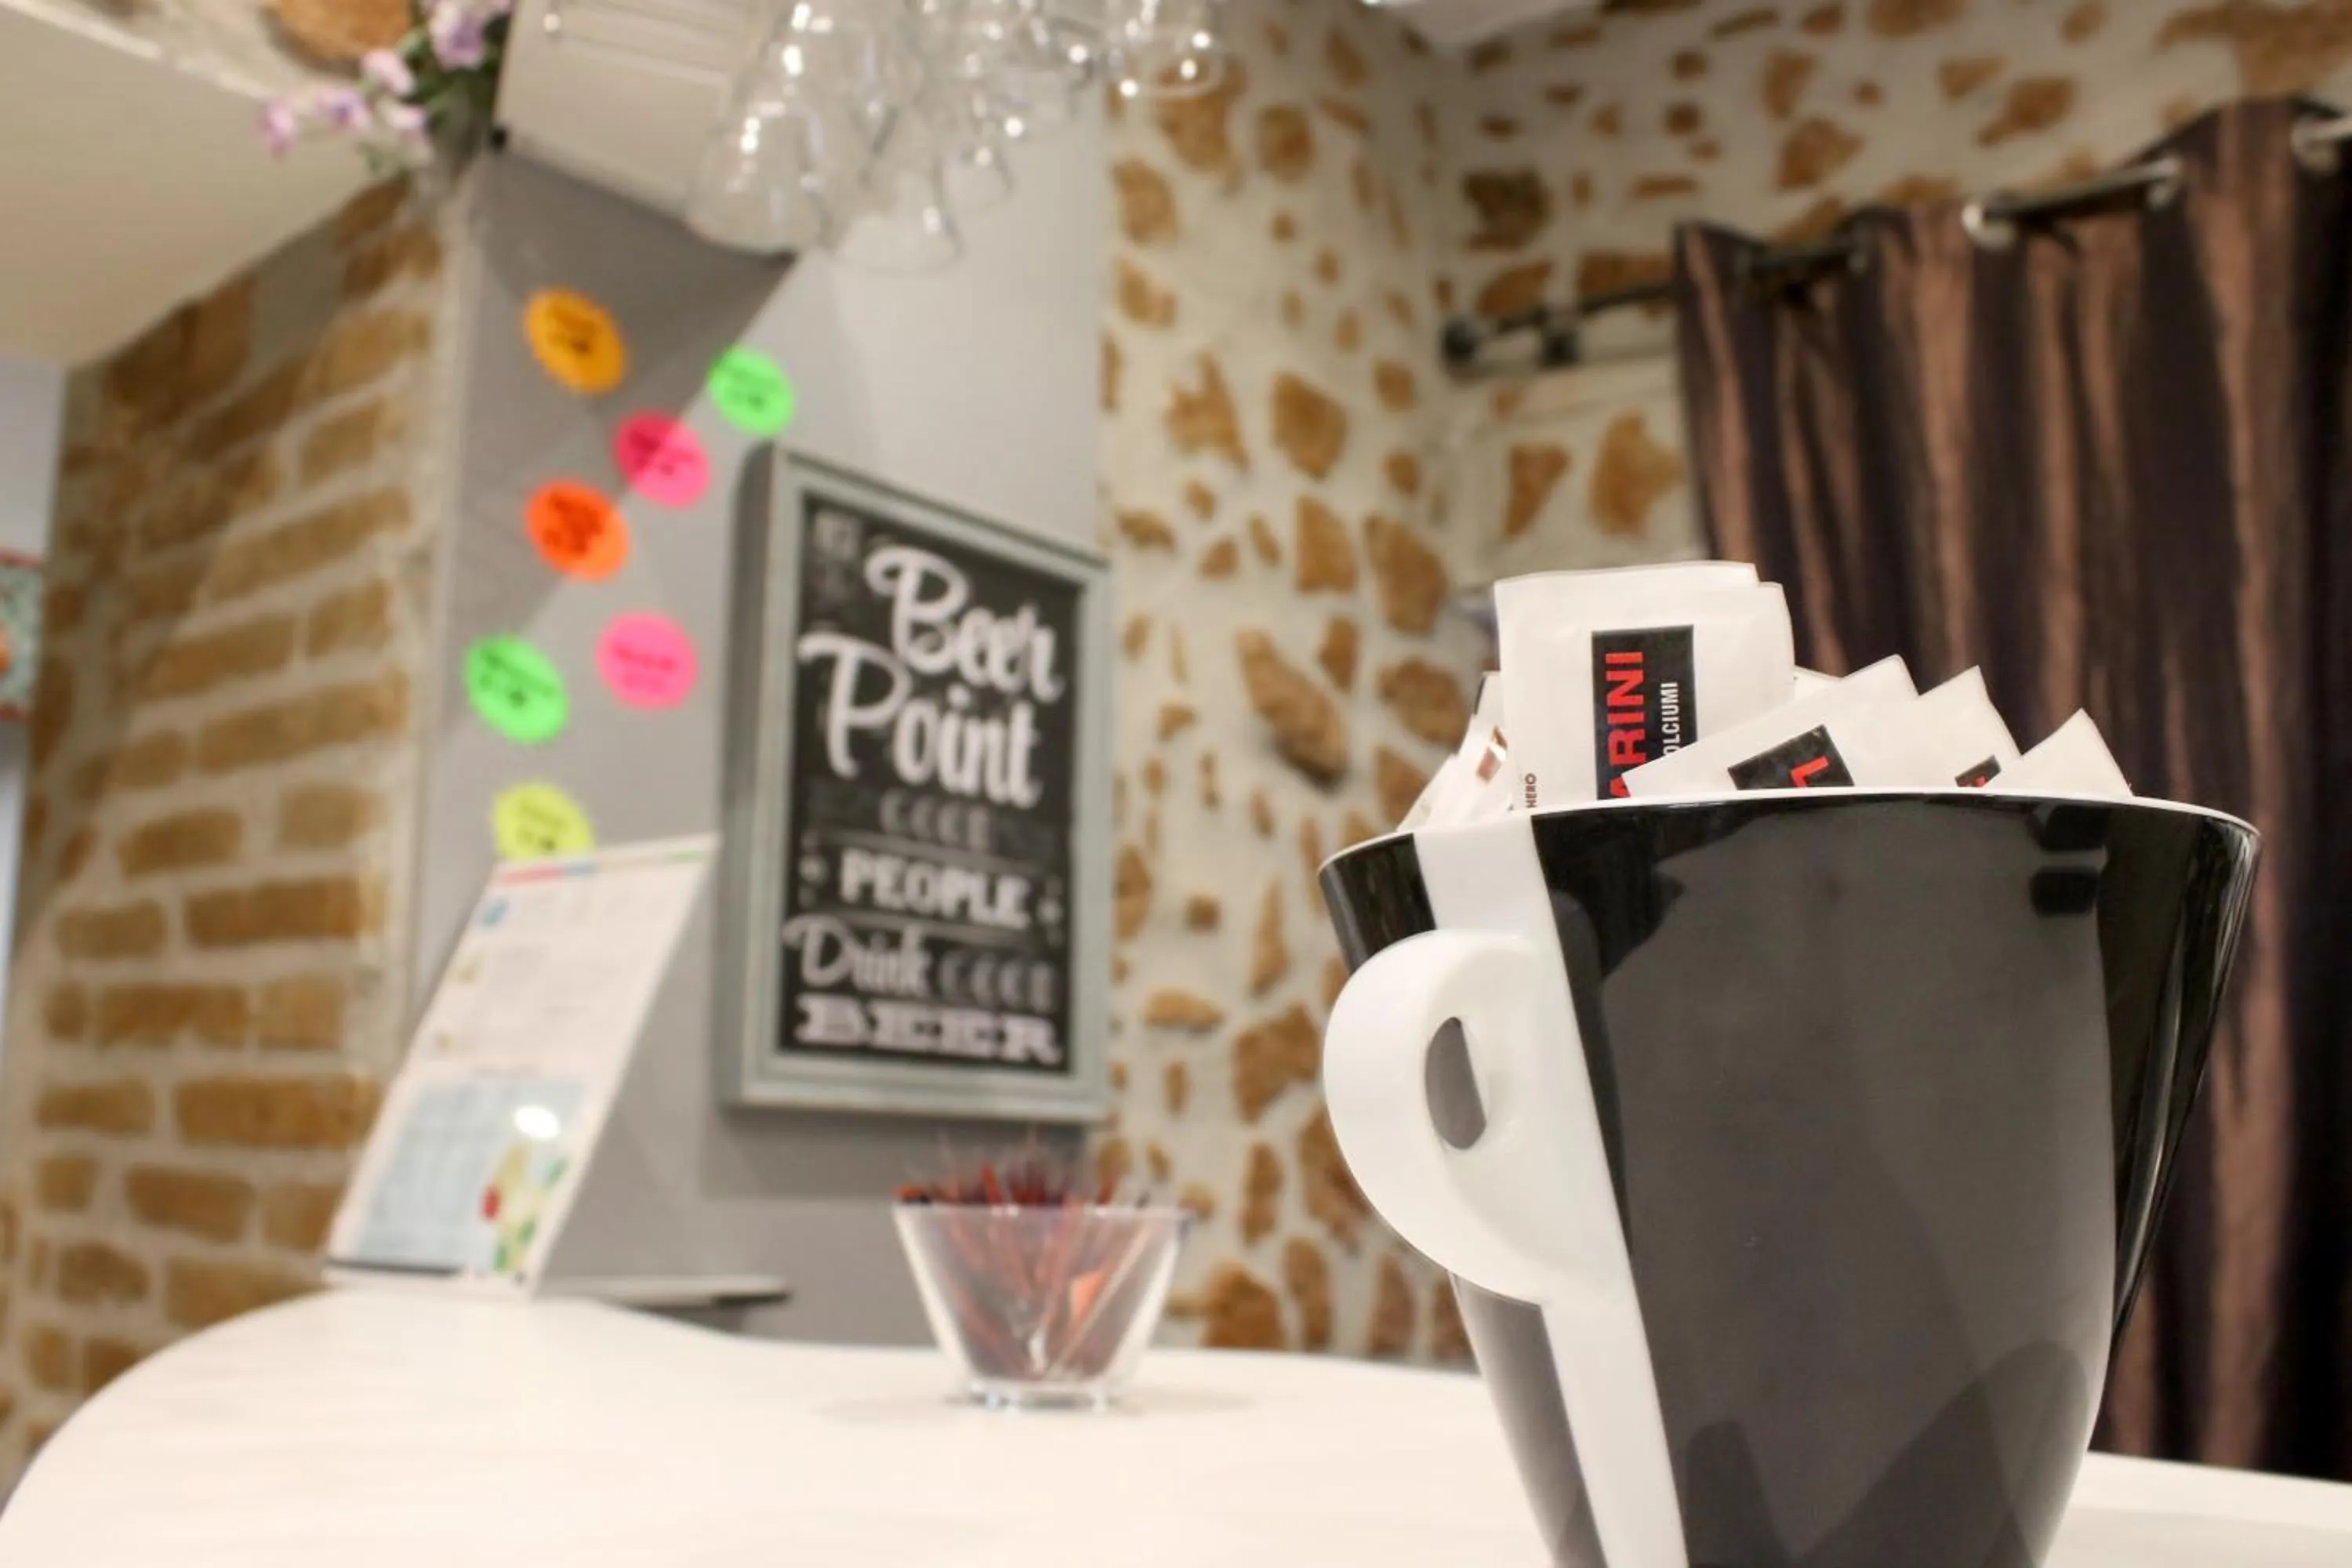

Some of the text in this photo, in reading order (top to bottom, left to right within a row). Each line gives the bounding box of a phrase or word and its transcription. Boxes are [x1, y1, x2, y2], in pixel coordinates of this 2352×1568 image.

[866, 545, 1065, 703] Beer
[797, 630, 1042, 808] Point
[840, 848, 1031, 931] PEOPLE
[782, 914, 931, 996] Drink
[793, 993, 1062, 1065] BEER
